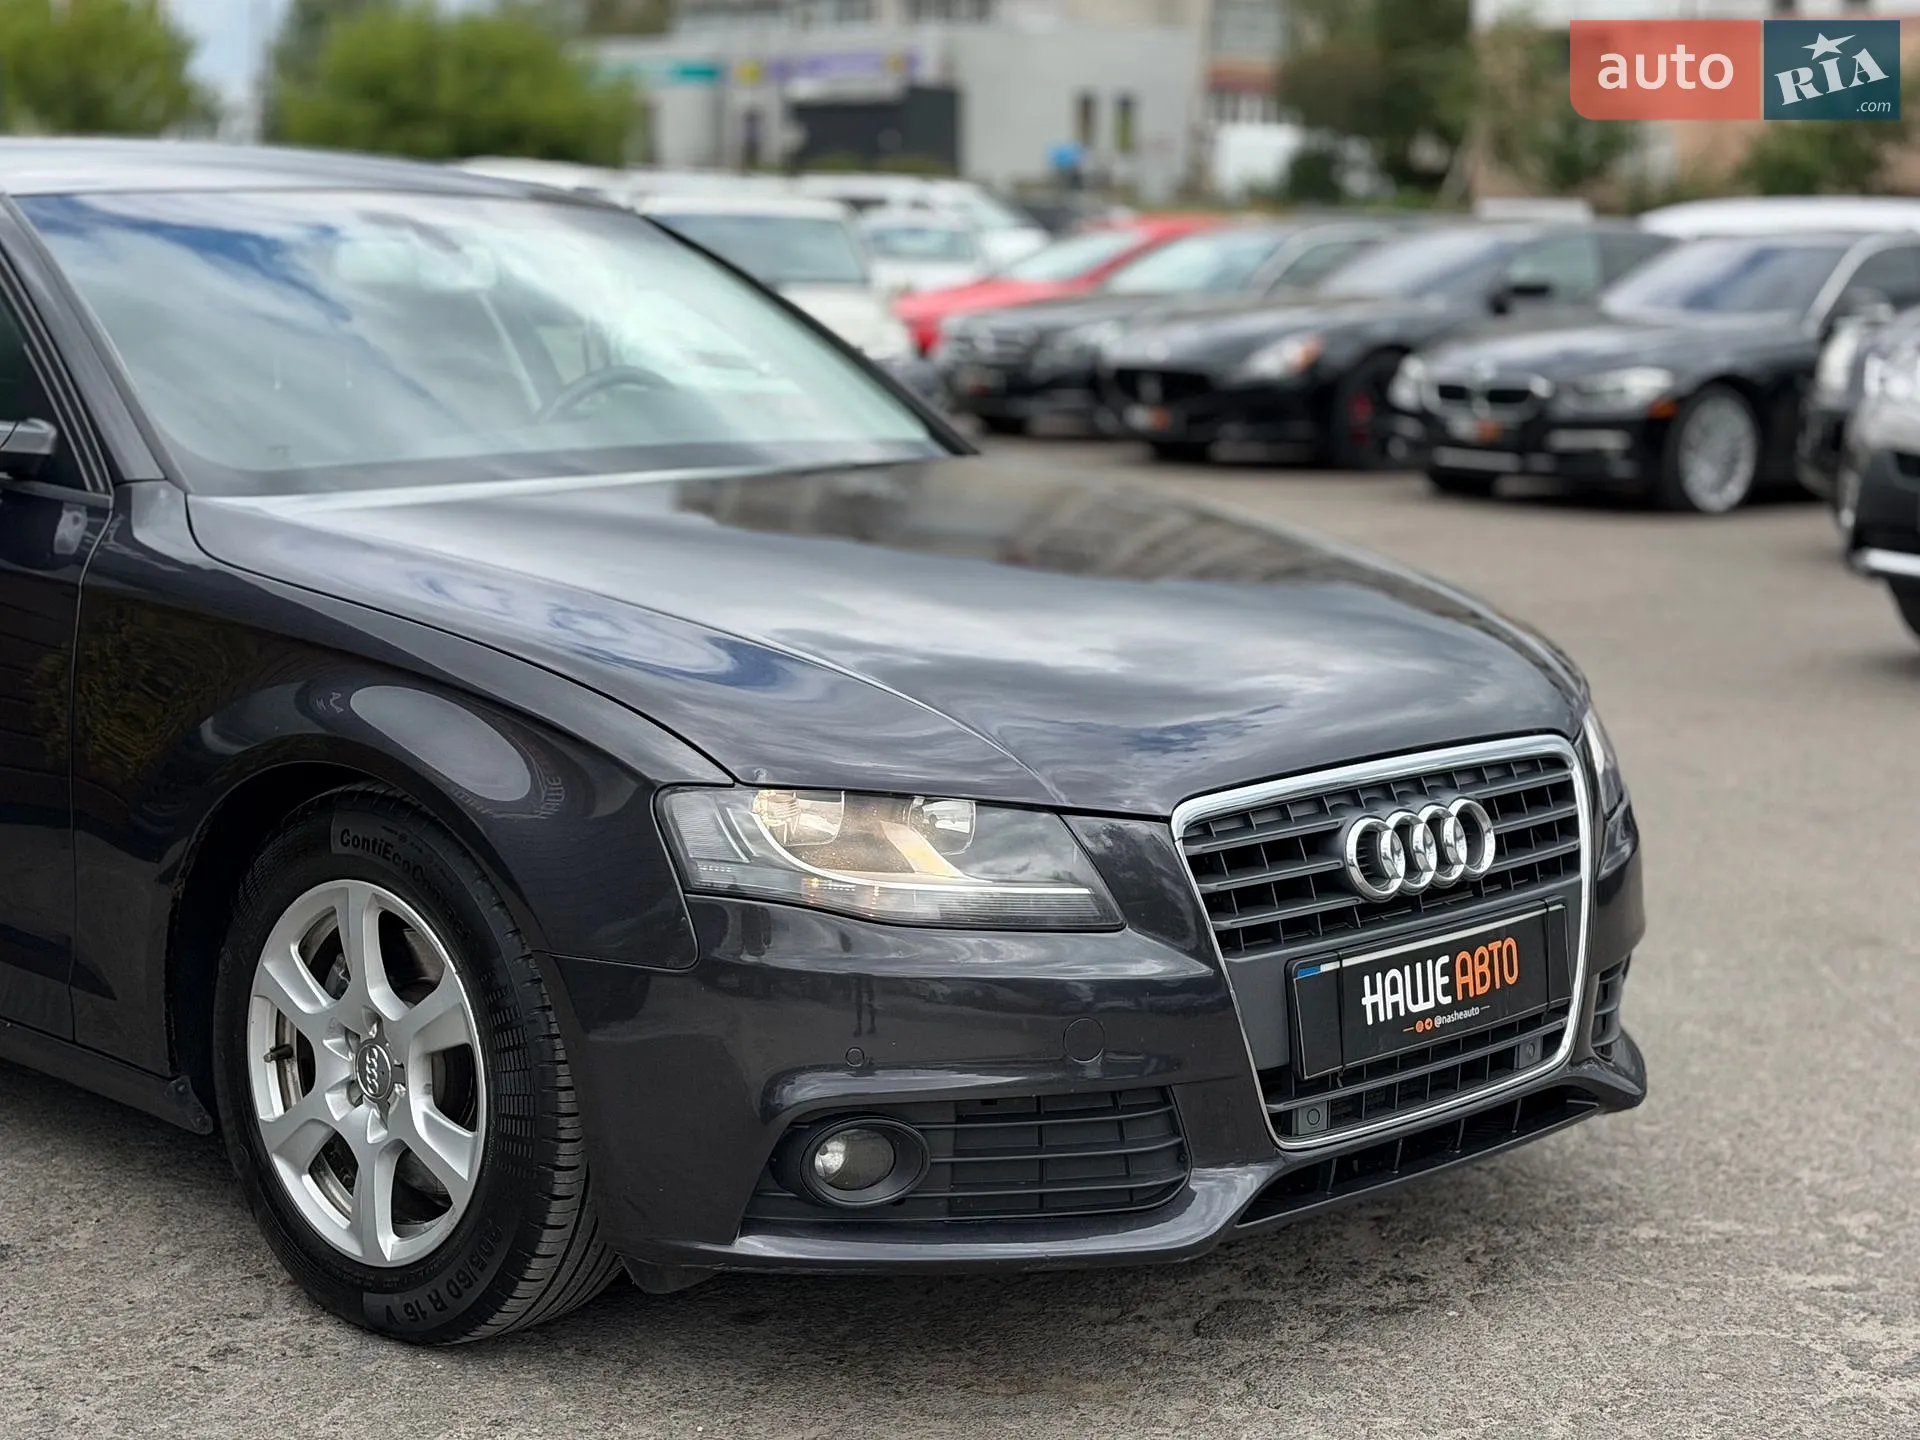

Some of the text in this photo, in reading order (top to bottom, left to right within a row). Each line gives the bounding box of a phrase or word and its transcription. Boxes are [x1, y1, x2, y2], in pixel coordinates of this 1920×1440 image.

[1361, 936, 1519, 1025] НАШЕ АВТО
[1433, 1006, 1480, 1027] @nasheauto
[403, 1298, 428, 1323] 16
[426, 1286, 448, 1314] R
